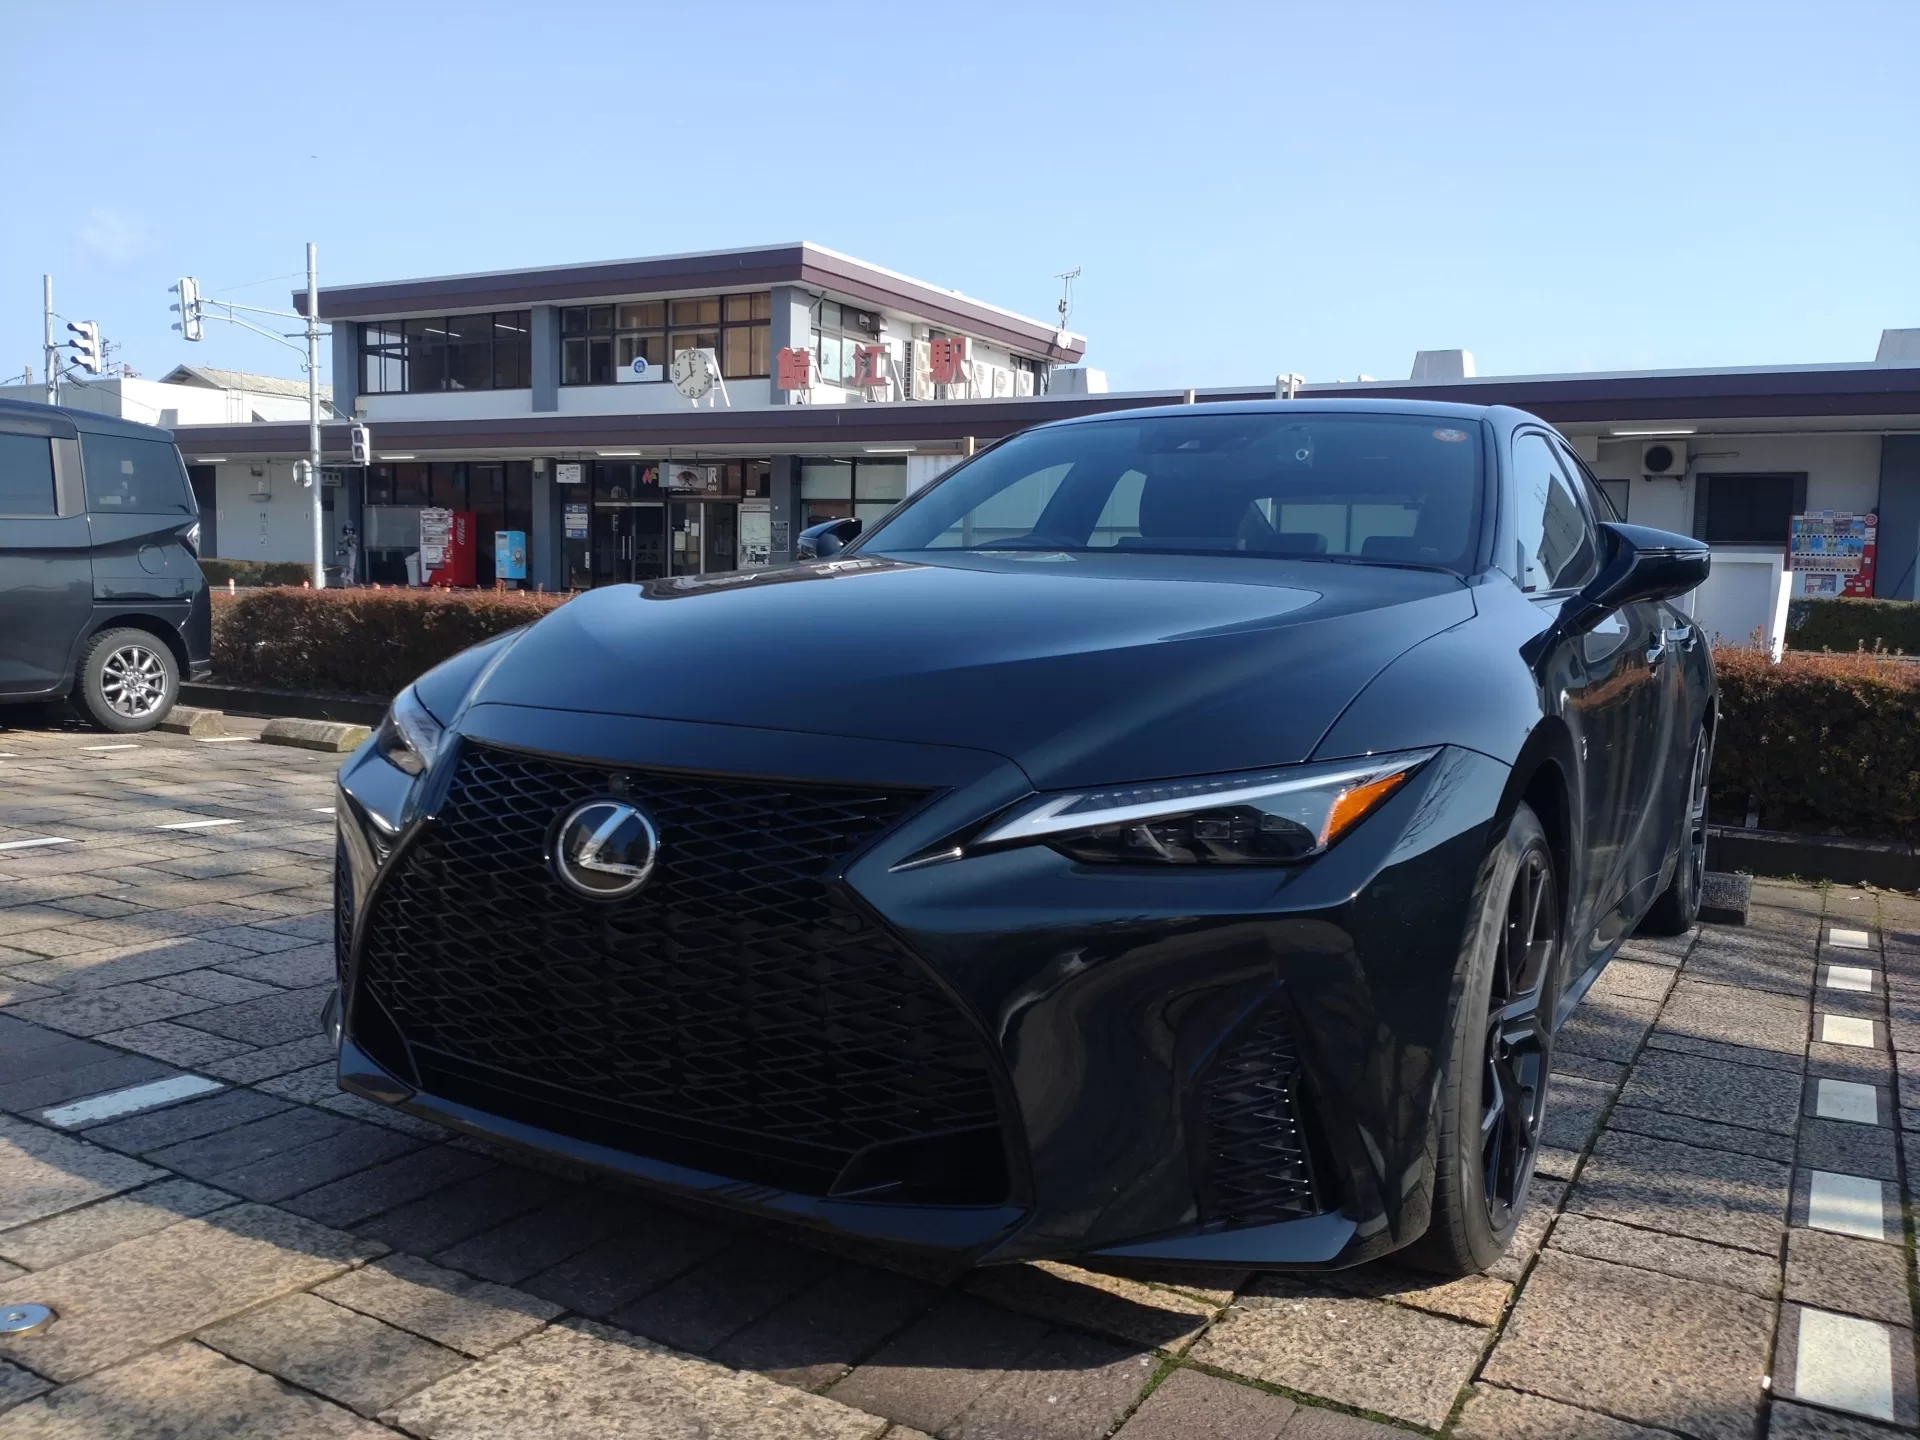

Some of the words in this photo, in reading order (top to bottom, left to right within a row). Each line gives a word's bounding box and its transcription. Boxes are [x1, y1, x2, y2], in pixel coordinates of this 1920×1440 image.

[689, 351, 696, 361] 12
[674, 369, 681, 379] 9
[689, 387, 695, 396] 6
